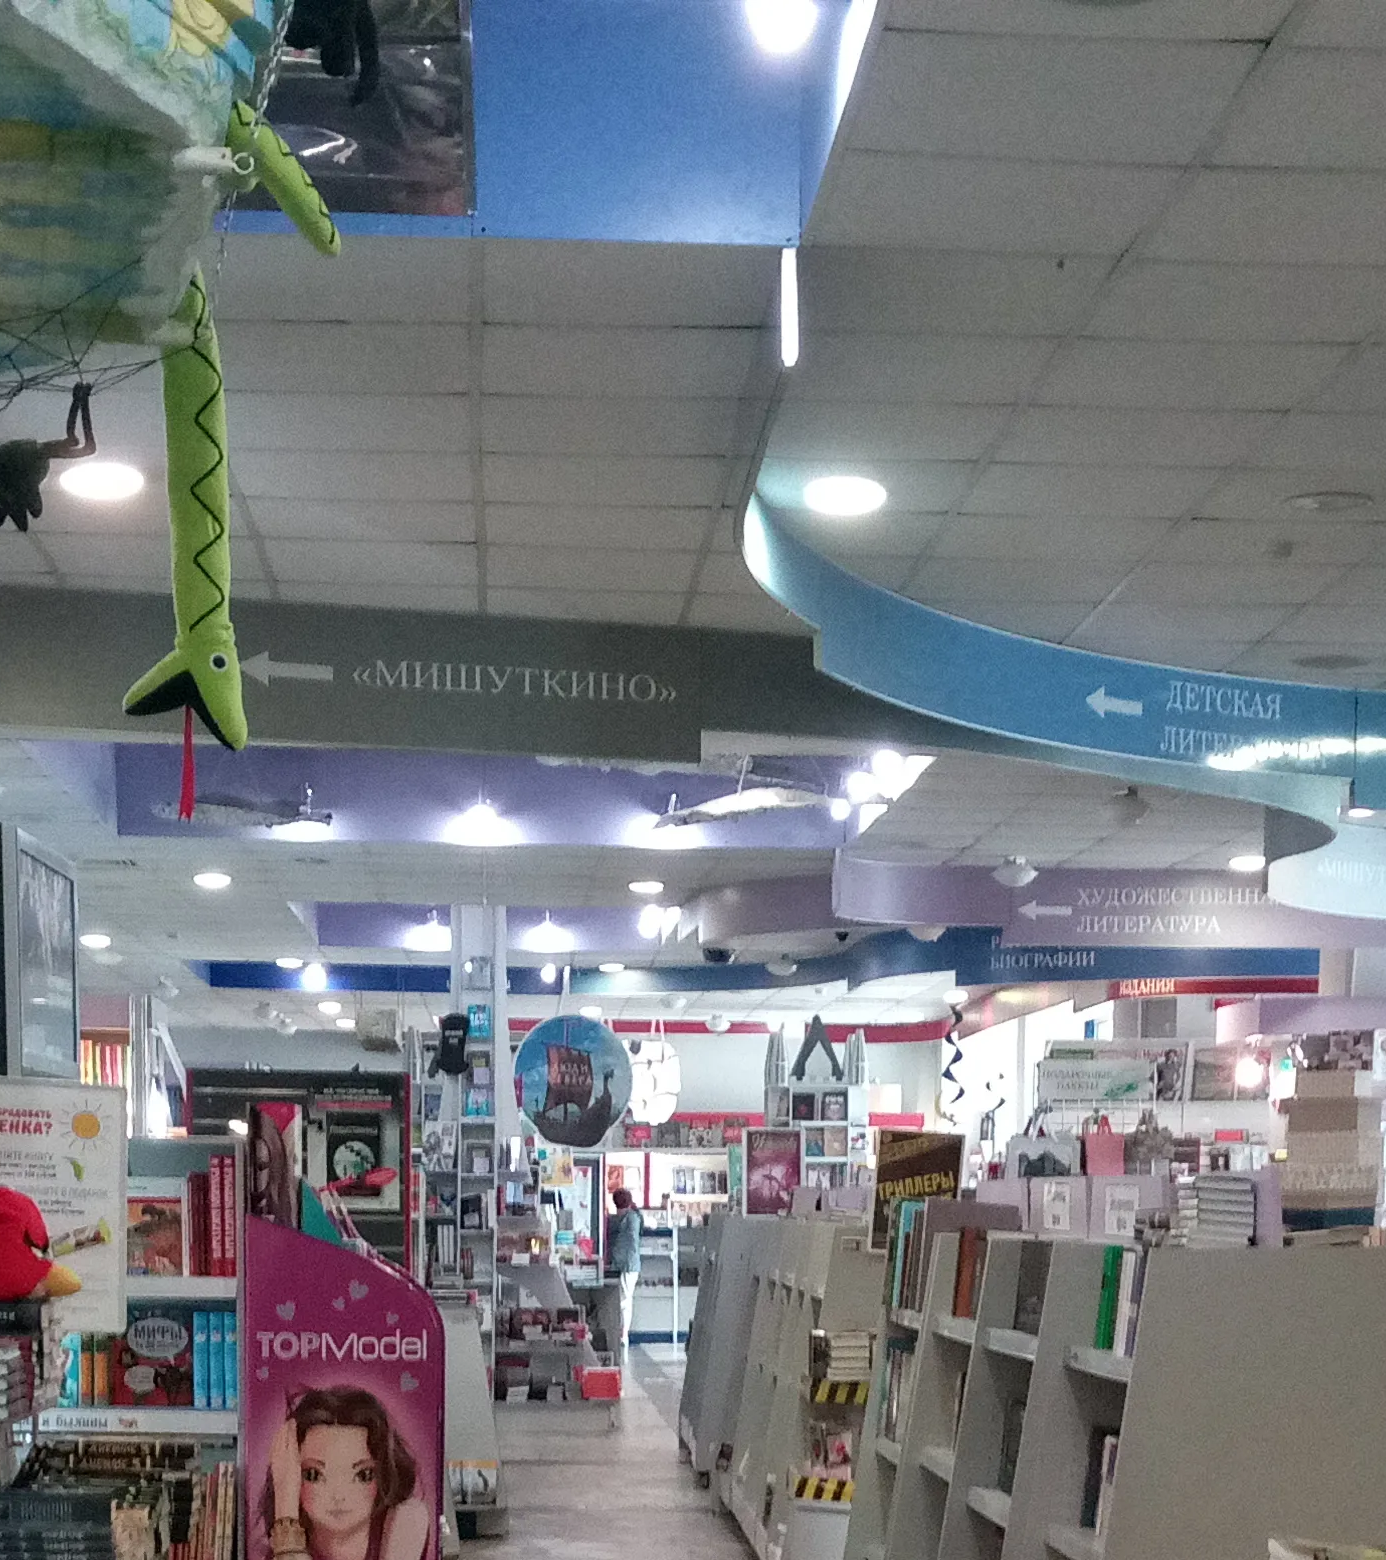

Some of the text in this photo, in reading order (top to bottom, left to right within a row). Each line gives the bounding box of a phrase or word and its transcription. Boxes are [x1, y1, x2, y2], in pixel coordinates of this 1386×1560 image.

[352, 659, 676, 702] «МИШУТКИНО»
[1165, 681, 1283, 720] ДЕТСКАЯ
[1076, 886, 1280, 909] ХУДОЖЕСТВЕНН
[1076, 913, 1222, 934] ЛИТЕРАТУРА
[990, 950, 1096, 969] БИОГРАФИИ
[1119, 977, 1176, 995] ИЗДАНИЯ
[133, 1323, 183, 1342] МИФЫ
